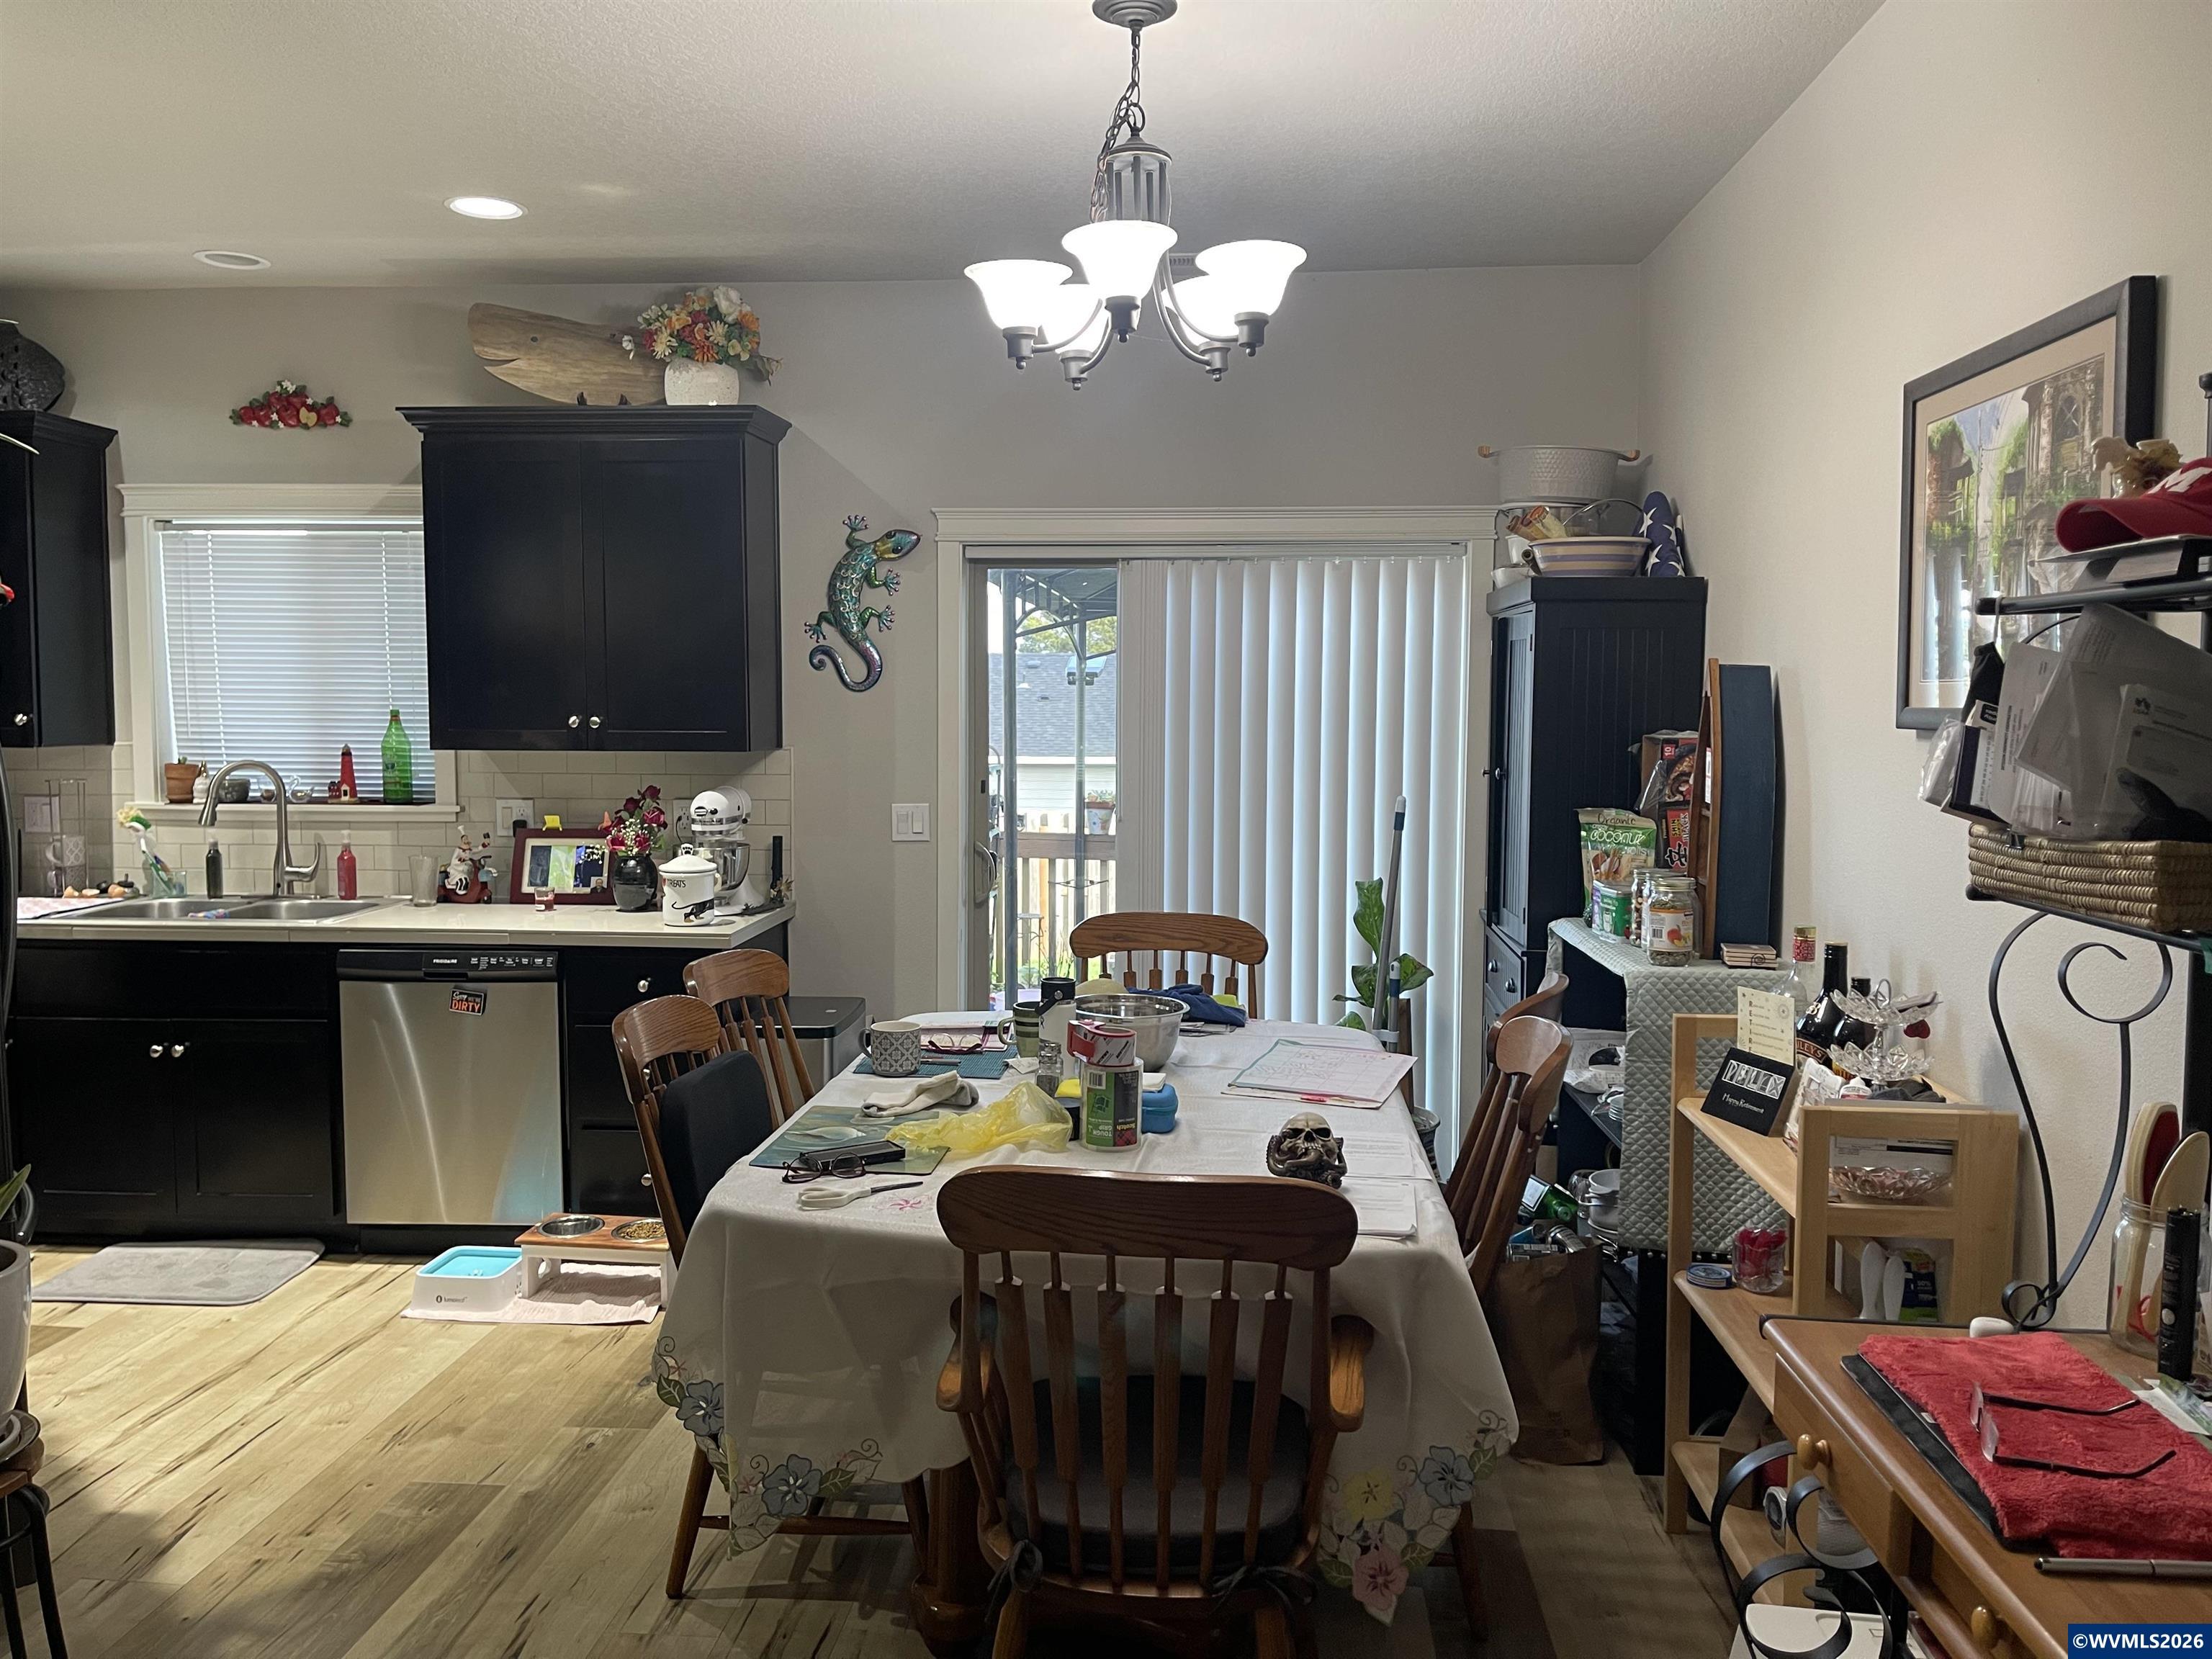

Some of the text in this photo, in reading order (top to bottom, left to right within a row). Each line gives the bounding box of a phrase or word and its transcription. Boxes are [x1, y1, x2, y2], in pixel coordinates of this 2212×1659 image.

[1598, 813, 1636, 829] Organic
[667, 879, 686, 888] TREATS
[452, 1000, 480, 1013] DIRTY
[1797, 1040, 1822, 1058] ILEYS
[1722, 1060, 1786, 1100] RELAX
